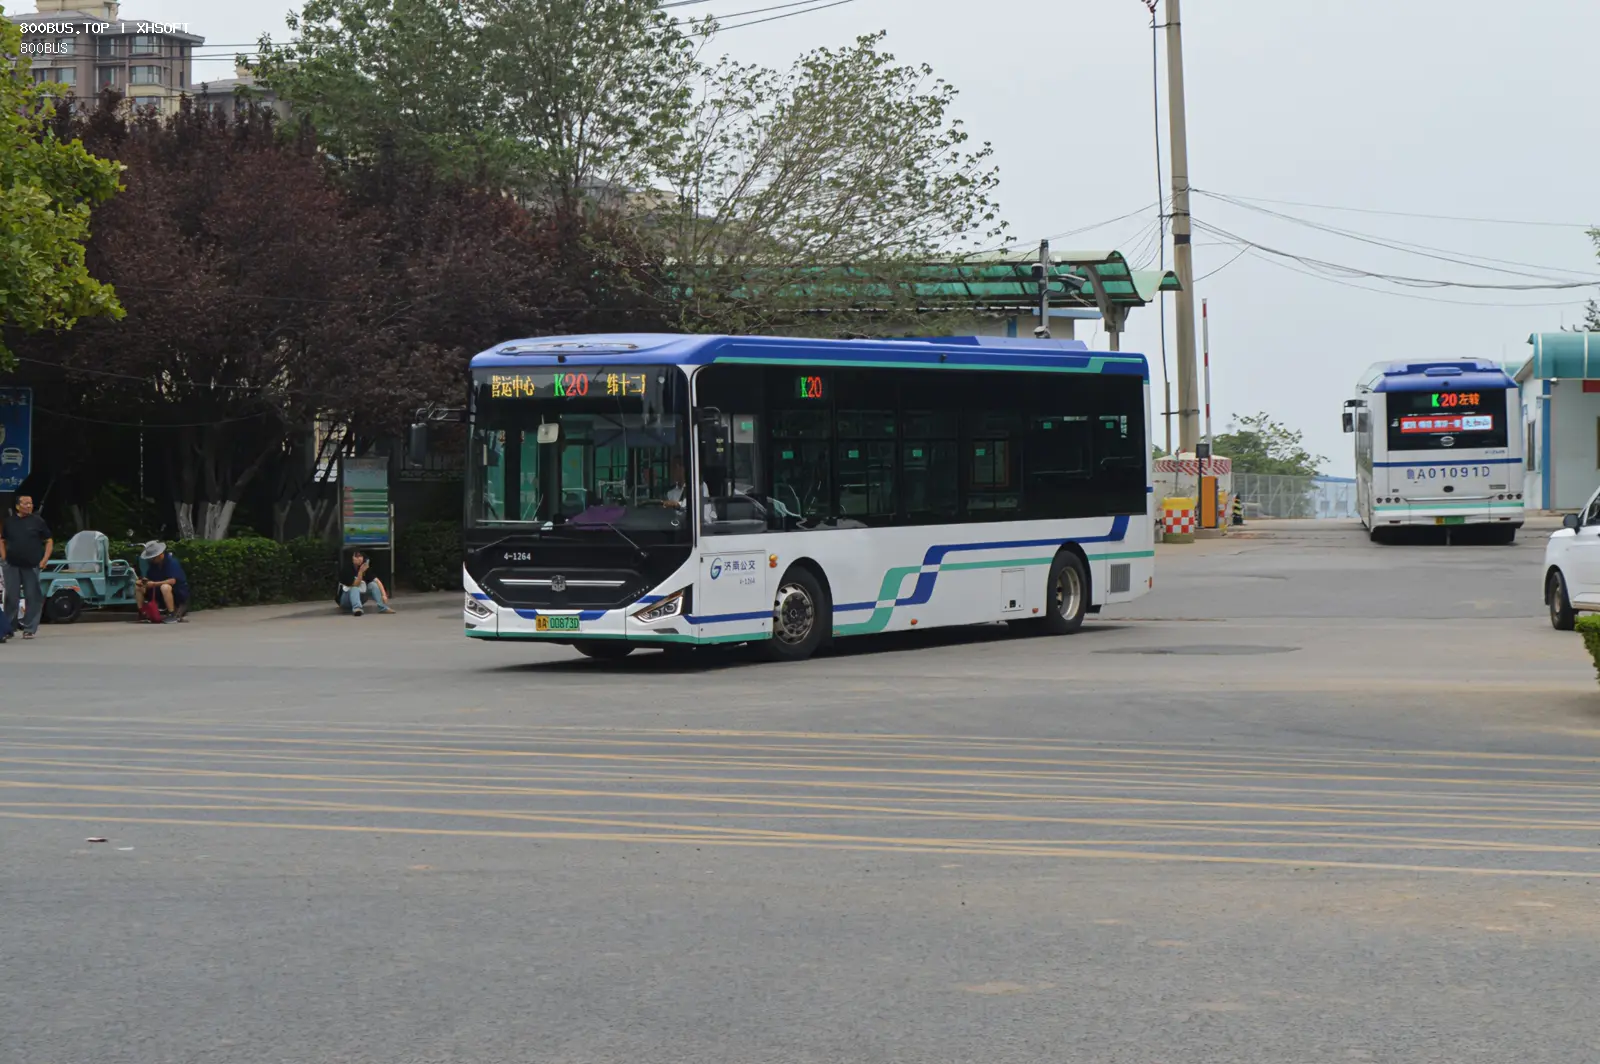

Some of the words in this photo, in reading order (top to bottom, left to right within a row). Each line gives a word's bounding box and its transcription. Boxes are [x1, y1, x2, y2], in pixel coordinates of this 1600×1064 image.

[553, 373, 589, 397] K20
[800, 376, 823, 398] K20
[503, 552, 531, 561] 4-1264
